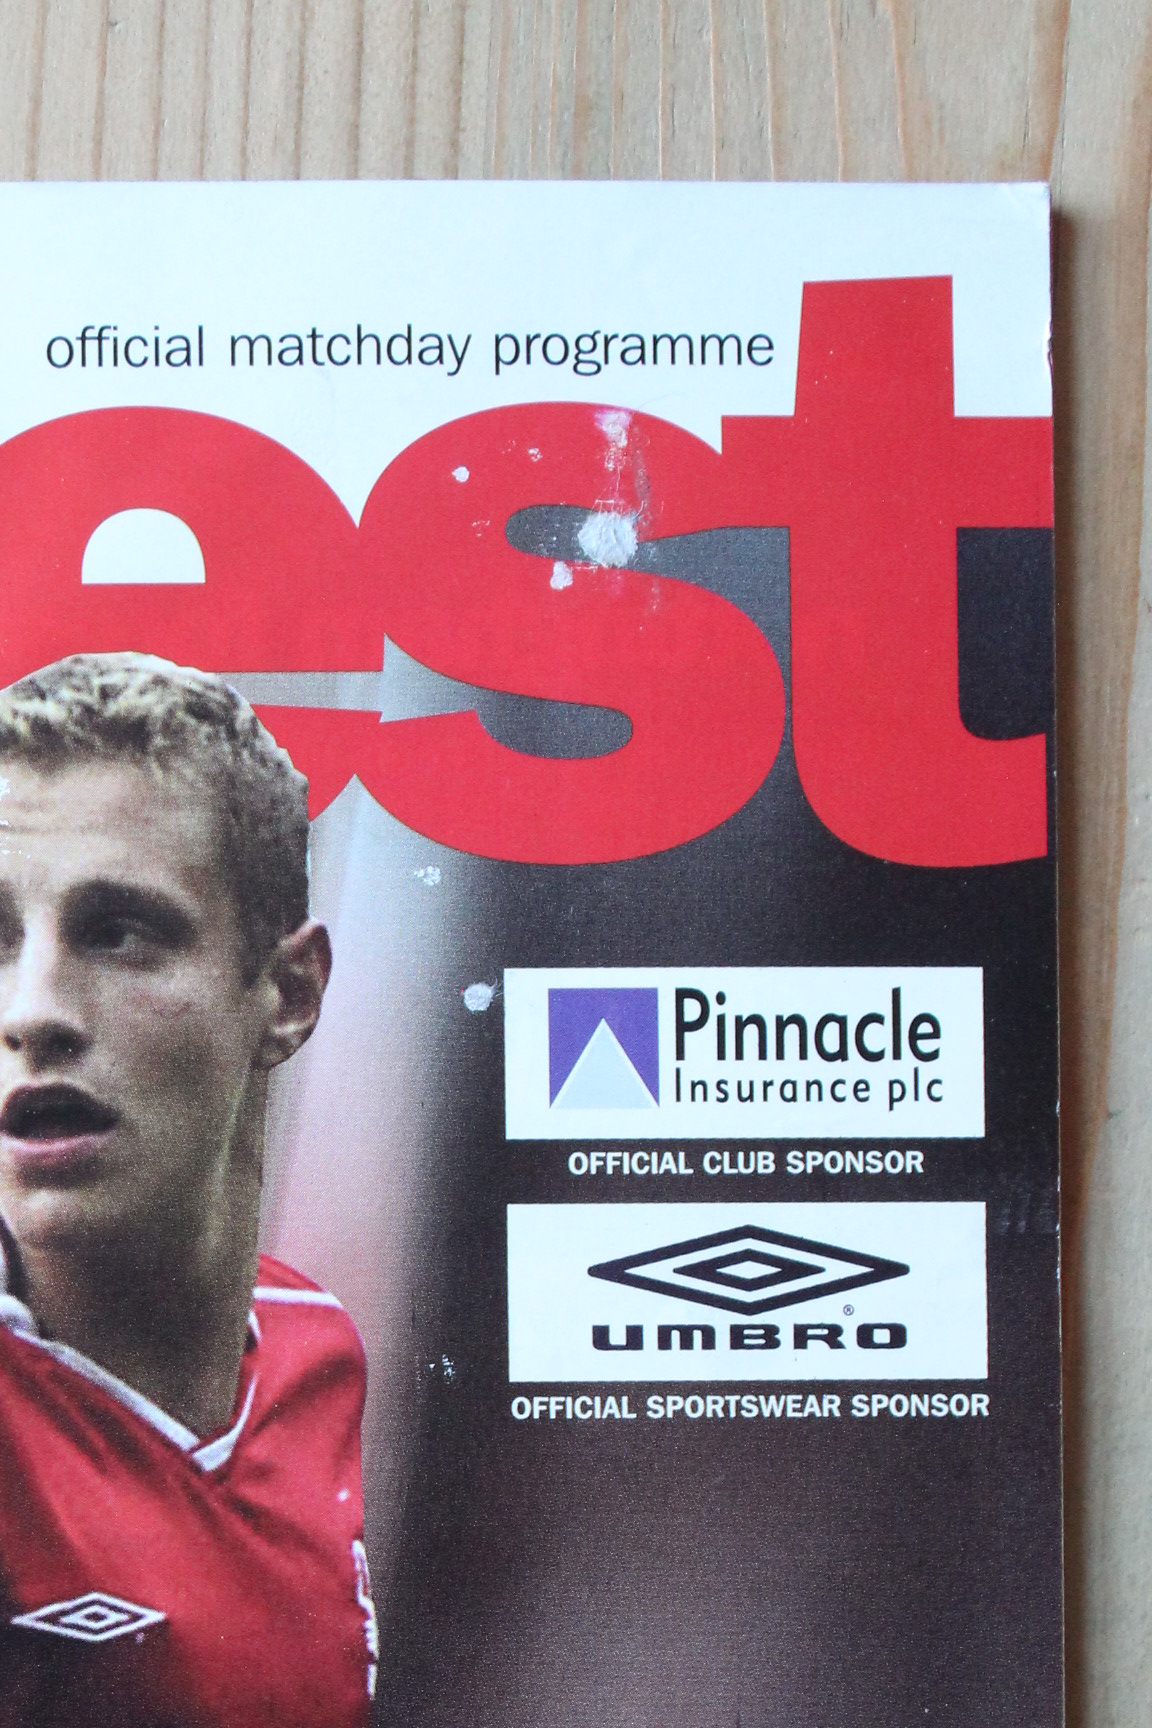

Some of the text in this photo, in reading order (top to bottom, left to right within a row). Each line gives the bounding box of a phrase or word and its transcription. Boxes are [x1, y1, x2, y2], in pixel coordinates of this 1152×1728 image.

[46, 324, 775, 377] official matchday programme
[674, 986, 942, 1063] Pinnacle
[674, 1066, 944, 1112] Insurance plc
[567, 1150, 925, 1175] OFFICIAL CLUB SPONSOR
[591, 1323, 908, 1351] UMBRO
[510, 1393, 991, 1420] OFFICIAL SPORTSWEAR SPONSOR
